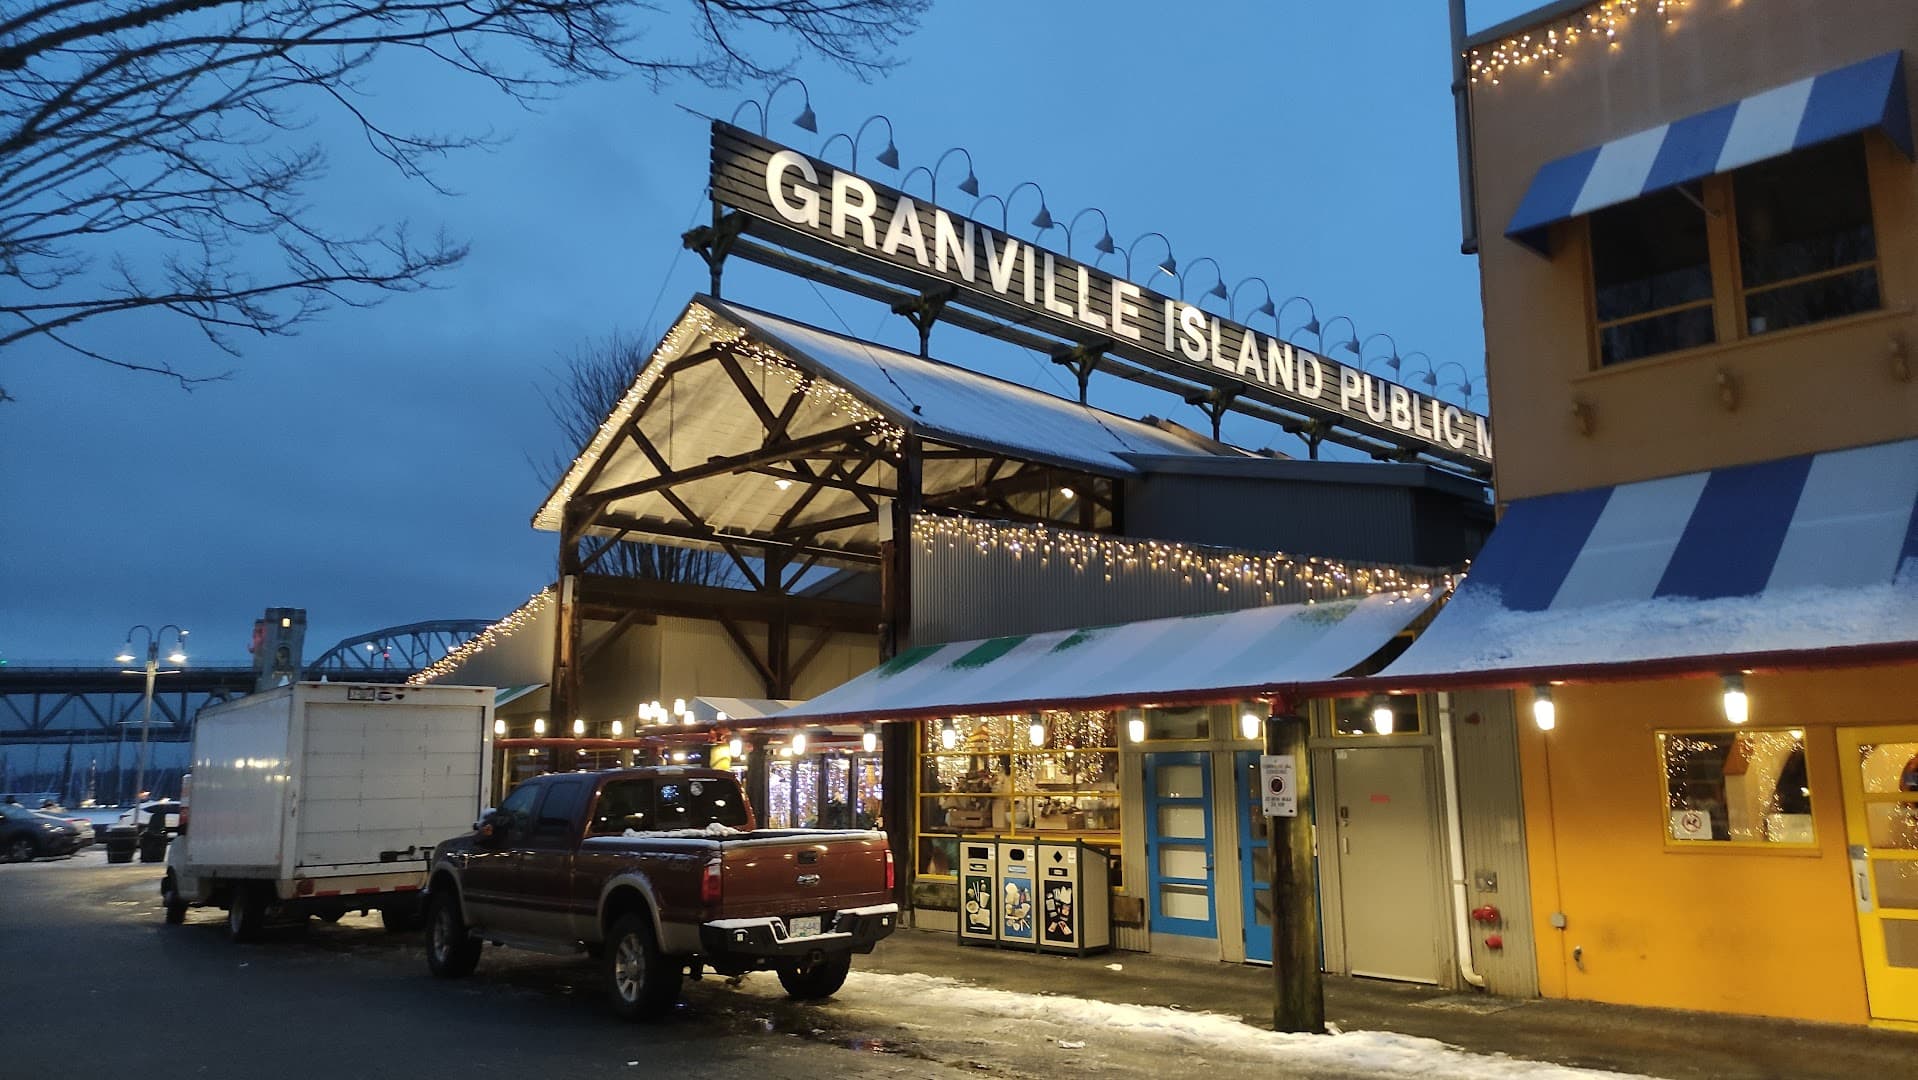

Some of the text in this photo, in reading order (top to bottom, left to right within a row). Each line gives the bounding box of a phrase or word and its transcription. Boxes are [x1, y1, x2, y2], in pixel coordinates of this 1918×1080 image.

[766, 150, 1141, 341] GRANVILLE
[1165, 299, 1323, 400] ISLAND
[1340, 365, 1465, 449] PUBLIC
